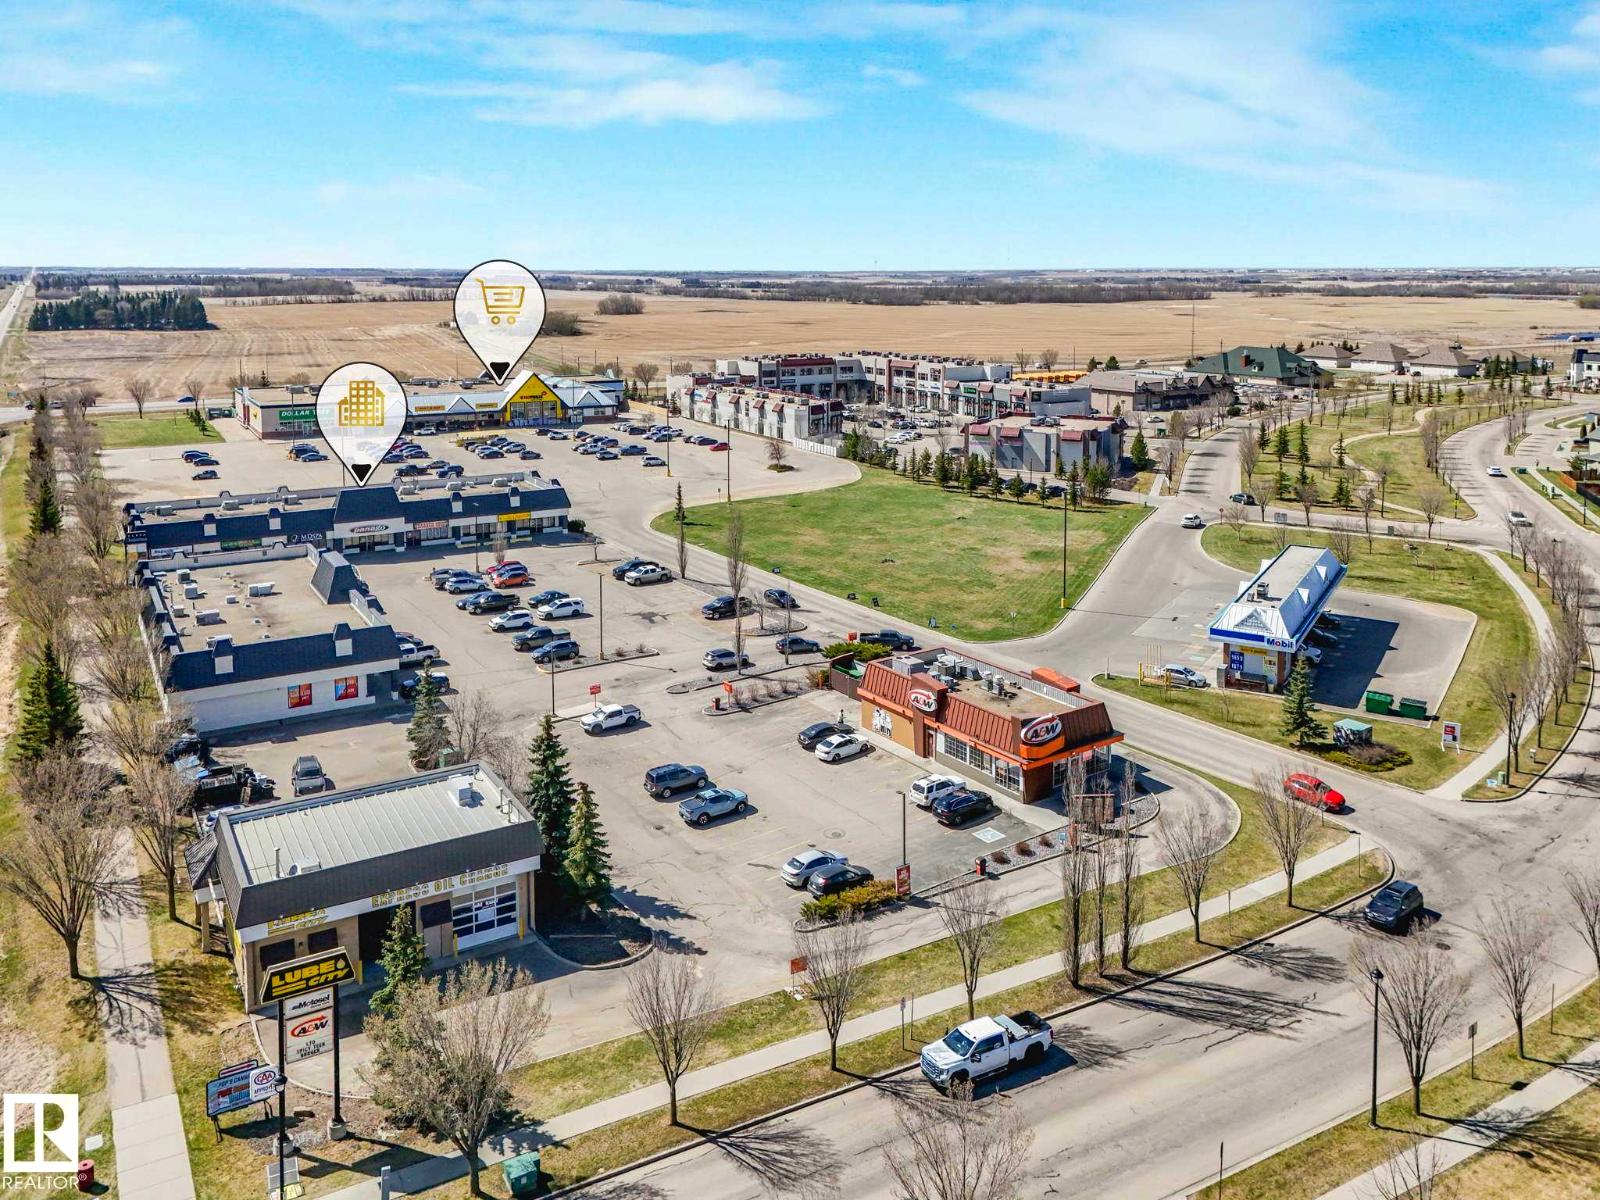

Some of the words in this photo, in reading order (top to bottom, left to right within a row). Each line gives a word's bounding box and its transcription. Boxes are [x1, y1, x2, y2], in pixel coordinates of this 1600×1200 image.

[1266, 638, 1293, 649] Mobil
[371, 883, 429, 908] EXPRESS
[433, 876, 455, 893] OIL
[459, 863, 508, 885] CHANGE
[271, 959, 335, 987] LUBE
[308, 967, 350, 987] CITY
